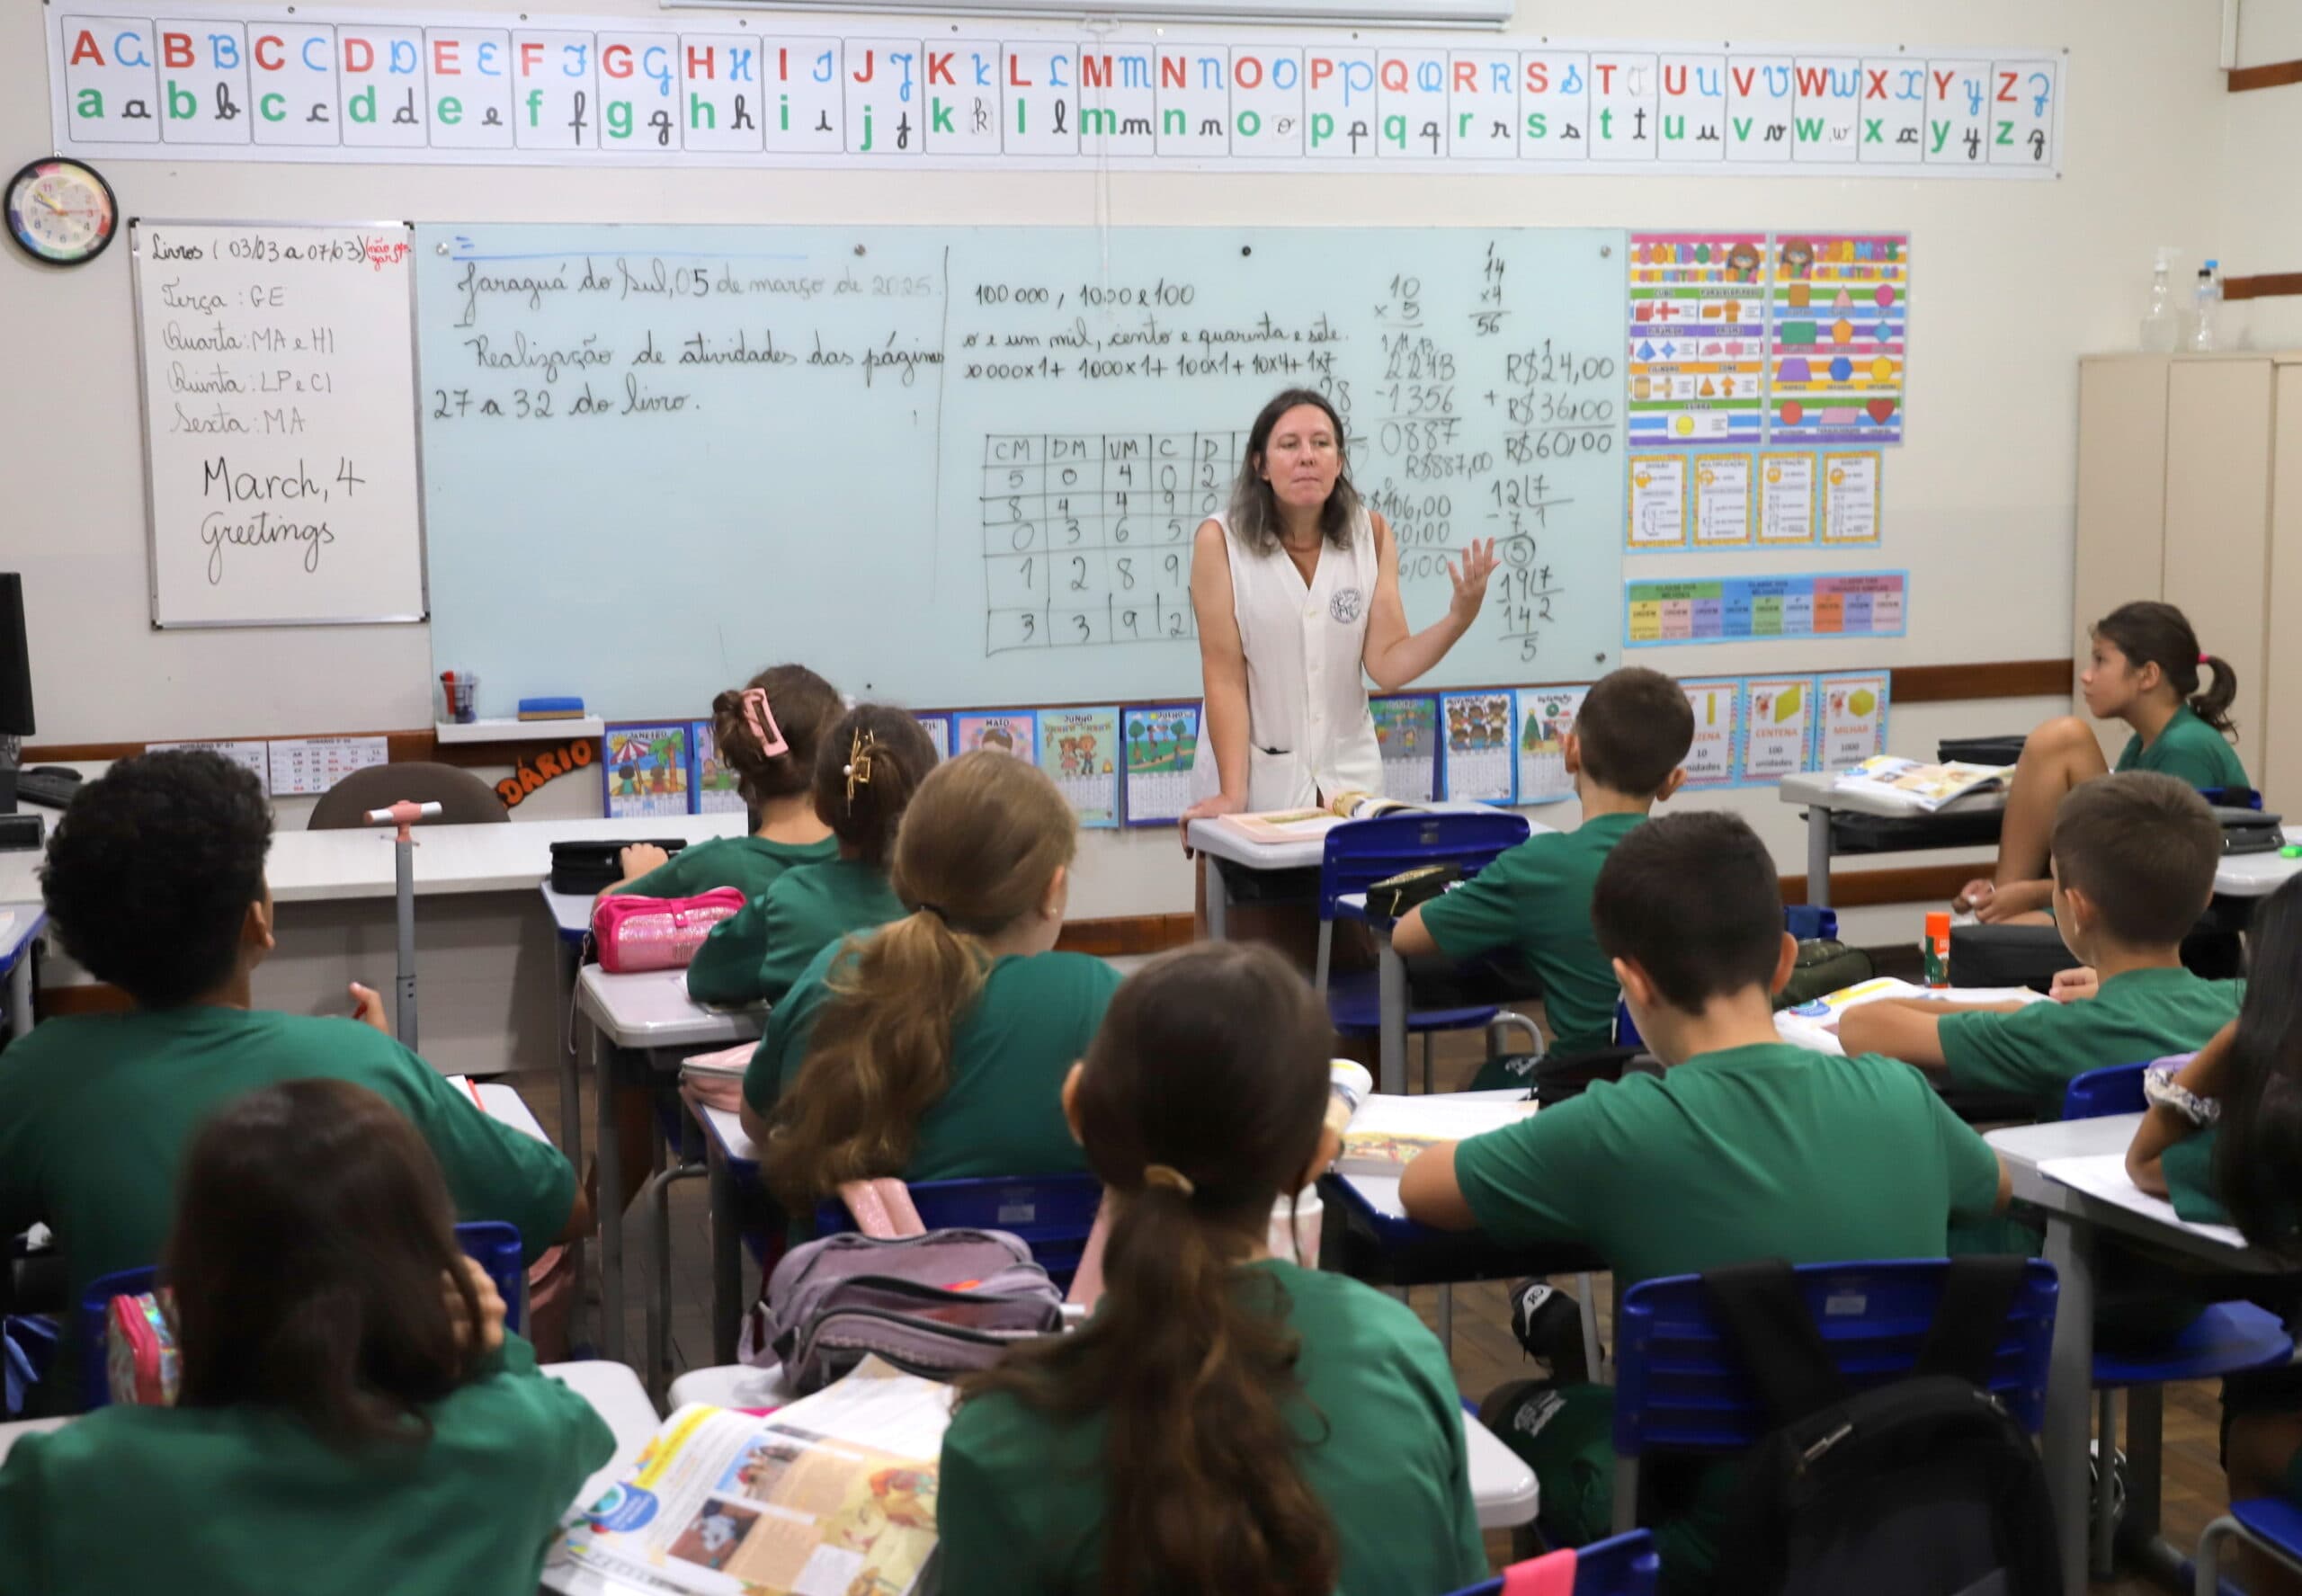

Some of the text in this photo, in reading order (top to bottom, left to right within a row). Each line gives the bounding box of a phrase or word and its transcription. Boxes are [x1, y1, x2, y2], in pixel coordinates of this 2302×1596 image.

[71, 30, 2019, 102] A B C D E F G H I J K L M N O P Q R S T U V W X Y Z
[76, 80, 2014, 154] a b c d e f g h i j k l m n o p q r s t u v w x y z
[152, 232, 203, 260] Livros
[284, 245, 304, 260] a
[1485, 256, 1504, 282] 14
[250, 284, 284, 308] GE
[454, 261, 568, 327] Jaraguá
[577, 256, 612, 293] do
[716, 262, 745, 294] de
[749, 276, 825, 300] março
[833, 265, 863, 295] de
[1389, 273, 1421, 299] 10
[1402, 299, 1420, 320] 5
[1004, 333, 1041, 347] um
[1108, 312, 1173, 346] cento
[1182, 333, 1192, 343] e
[1198, 311, 1289, 355] quarenta
[1293, 332, 1304, 343] e
[1476, 312, 1502, 336] 56
[293, 336, 308, 351] e
[312, 326, 334, 353] HI
[464, 330, 614, 383] Realização
[631, 330, 665, 366] de
[679, 329, 798, 365] atividades
[807, 329, 856, 366] das
[1506, 348, 1615, 386] R$24,00
[296, 380, 306, 392] e
[311, 371, 332, 394] CI
[433, 389, 474, 419] 27
[480, 398, 505, 418] a
[514, 389, 554, 419] 32
[568, 382, 615, 416] do
[995, 438, 1031, 461] CM
[1053, 438, 1086, 459] DM
[1159, 439, 1178, 457] C
[1203, 439, 1218, 462] D
[1380, 418, 1460, 456] 0887
[204, 456, 365, 503] March, 4
[1008, 463, 1219, 492] 5 0 4 0 2
[1491, 478, 1521, 509] 12
[201, 511, 335, 584] Greetings
[1500, 567, 1529, 602] 19
[1521, 636, 1539, 663] 5
[1755, 727, 1798, 738] CENTENA
[1834, 726, 1869, 735] MILHAR
[1697, 748, 1708, 758] 10
[1768, 745, 1783, 755] 100
[1841, 742, 1860, 753] 1000
